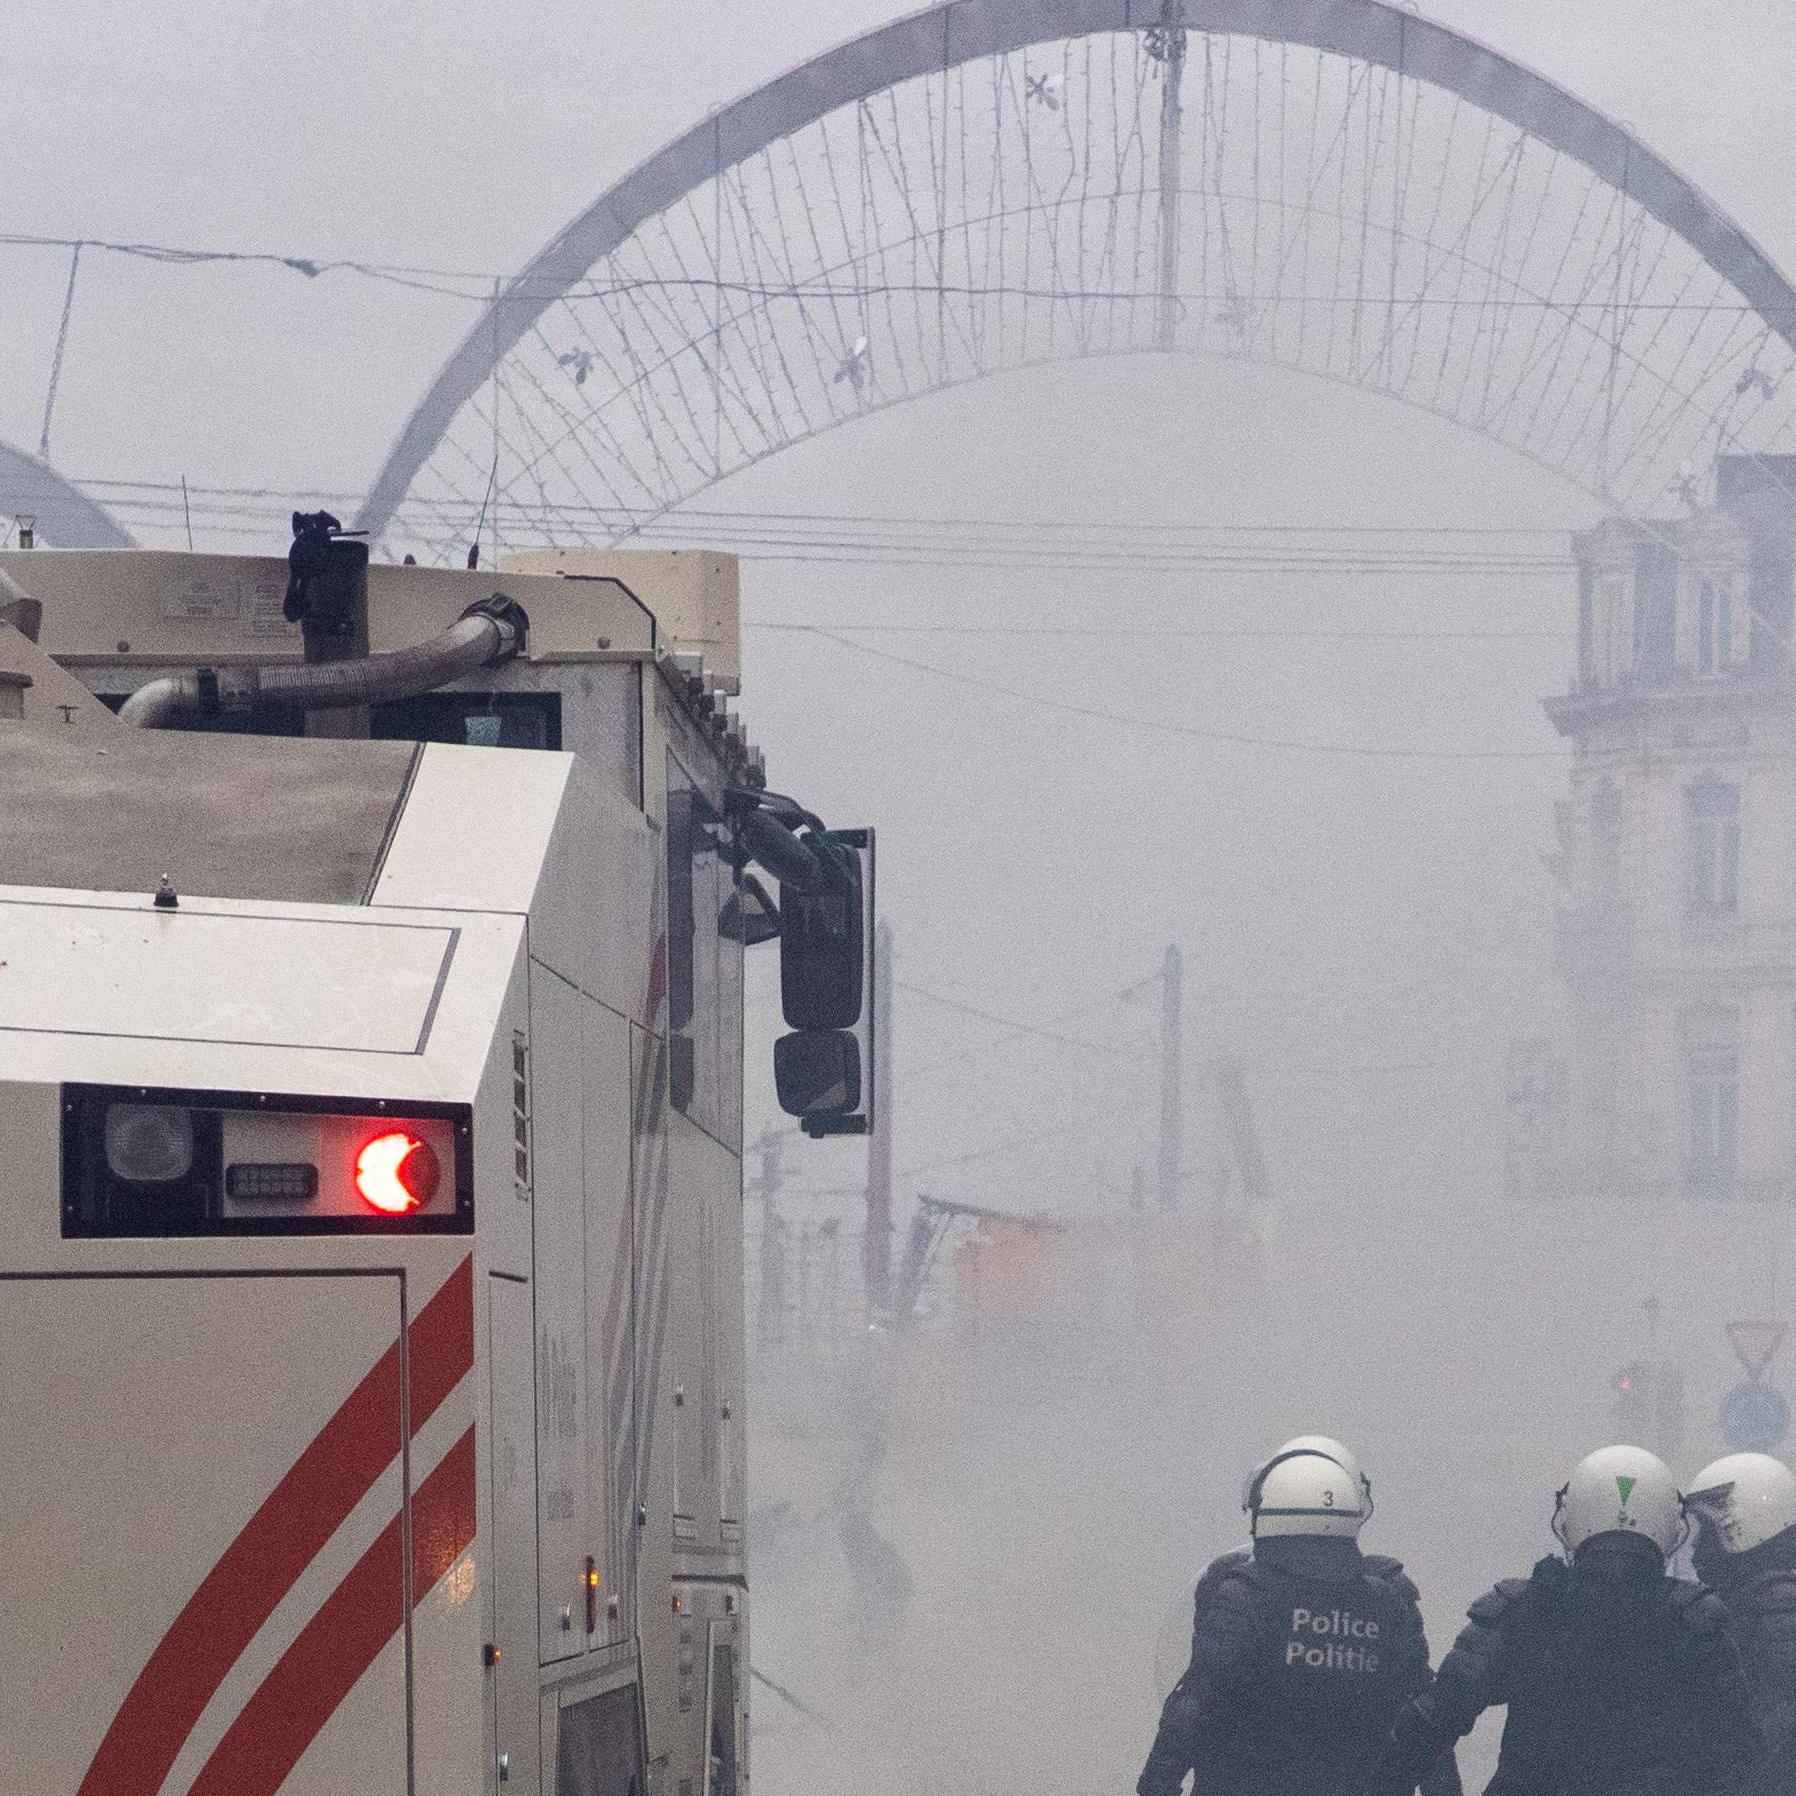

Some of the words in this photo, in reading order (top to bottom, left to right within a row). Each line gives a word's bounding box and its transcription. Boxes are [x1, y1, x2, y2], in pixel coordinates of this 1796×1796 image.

[1323, 1490, 1334, 1507] 3
[1292, 1607, 1380, 1639] Police
[1285, 1641, 1379, 1672] Politie
